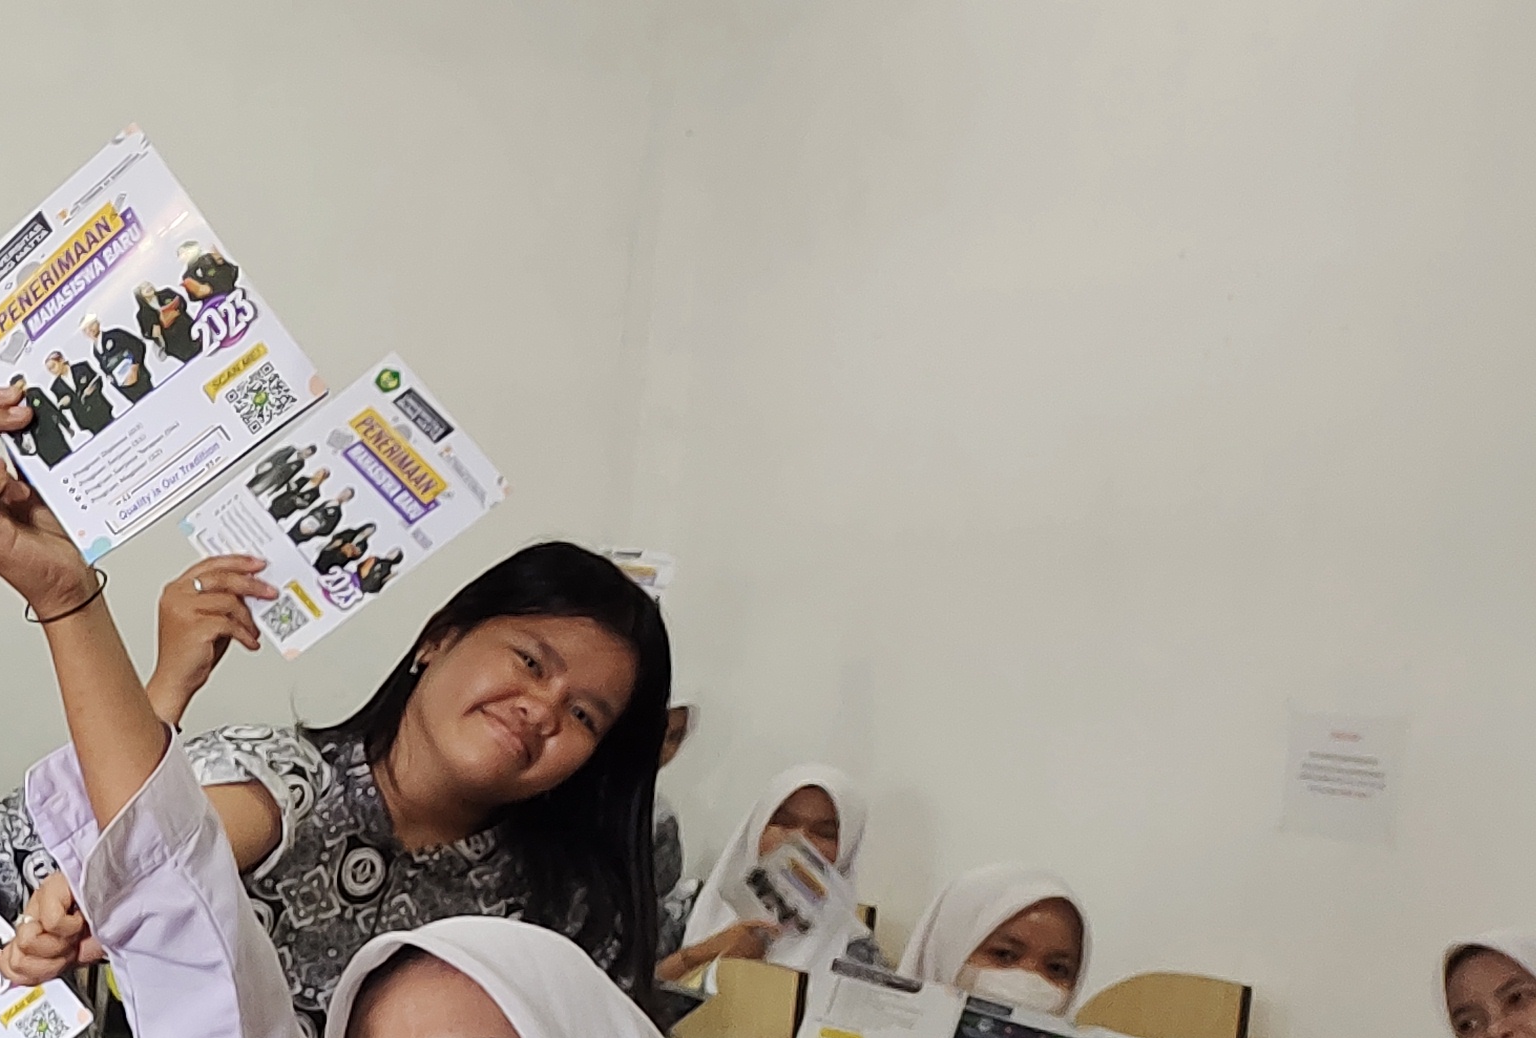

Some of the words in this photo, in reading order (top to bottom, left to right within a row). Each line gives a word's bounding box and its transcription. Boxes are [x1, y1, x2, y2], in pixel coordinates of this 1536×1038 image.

[27, 260, 106, 335] MAHASISWA
[102, 223, 142, 268] BARU
[190, 289, 258, 357] 2023
[118, 492, 152, 521] Quality
[161, 473, 181, 489] Our
[179, 441, 220, 476] Tradition
[355, 415, 439, 496] PENERIMAAN
